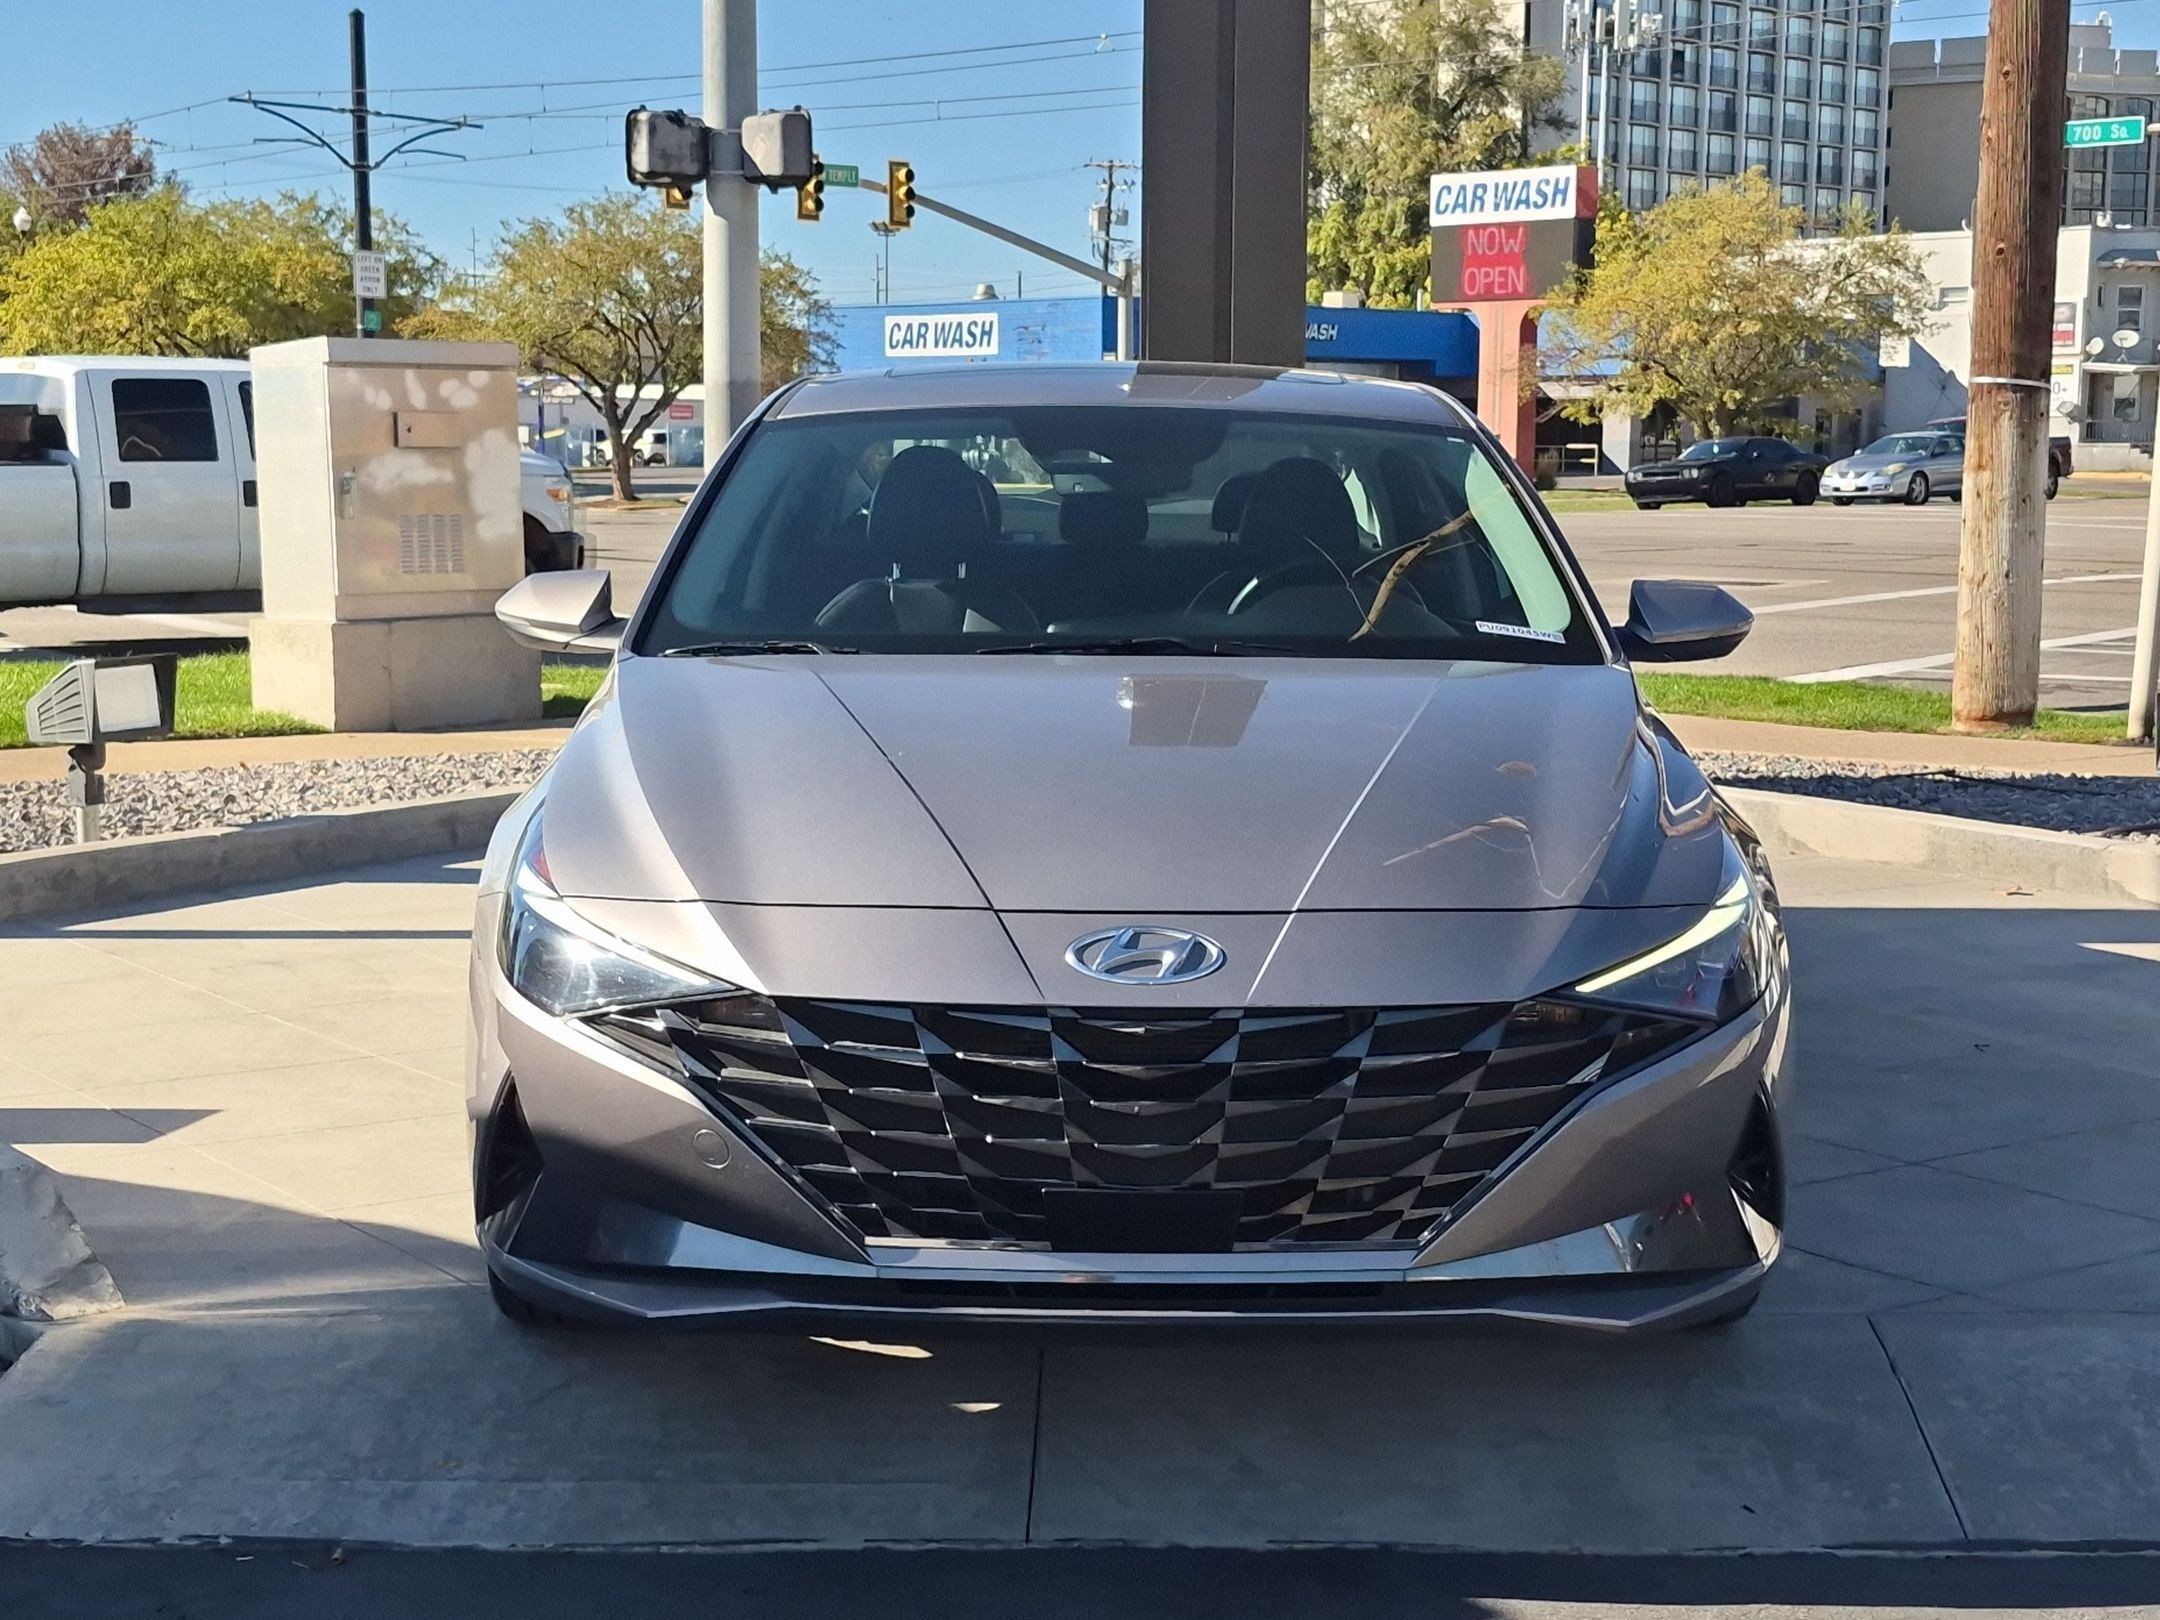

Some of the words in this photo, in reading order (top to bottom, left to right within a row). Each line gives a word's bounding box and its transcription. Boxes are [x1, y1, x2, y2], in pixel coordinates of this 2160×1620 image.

[2073, 125, 2102, 142] 700
[1435, 182, 1488, 216] CAR
[1493, 176, 1571, 212] WASH
[1467, 225, 1524, 256] NOW
[1464, 265, 1525, 296] OPEN
[889, 321, 930, 350] CAR
[933, 320, 995, 349] WASH
